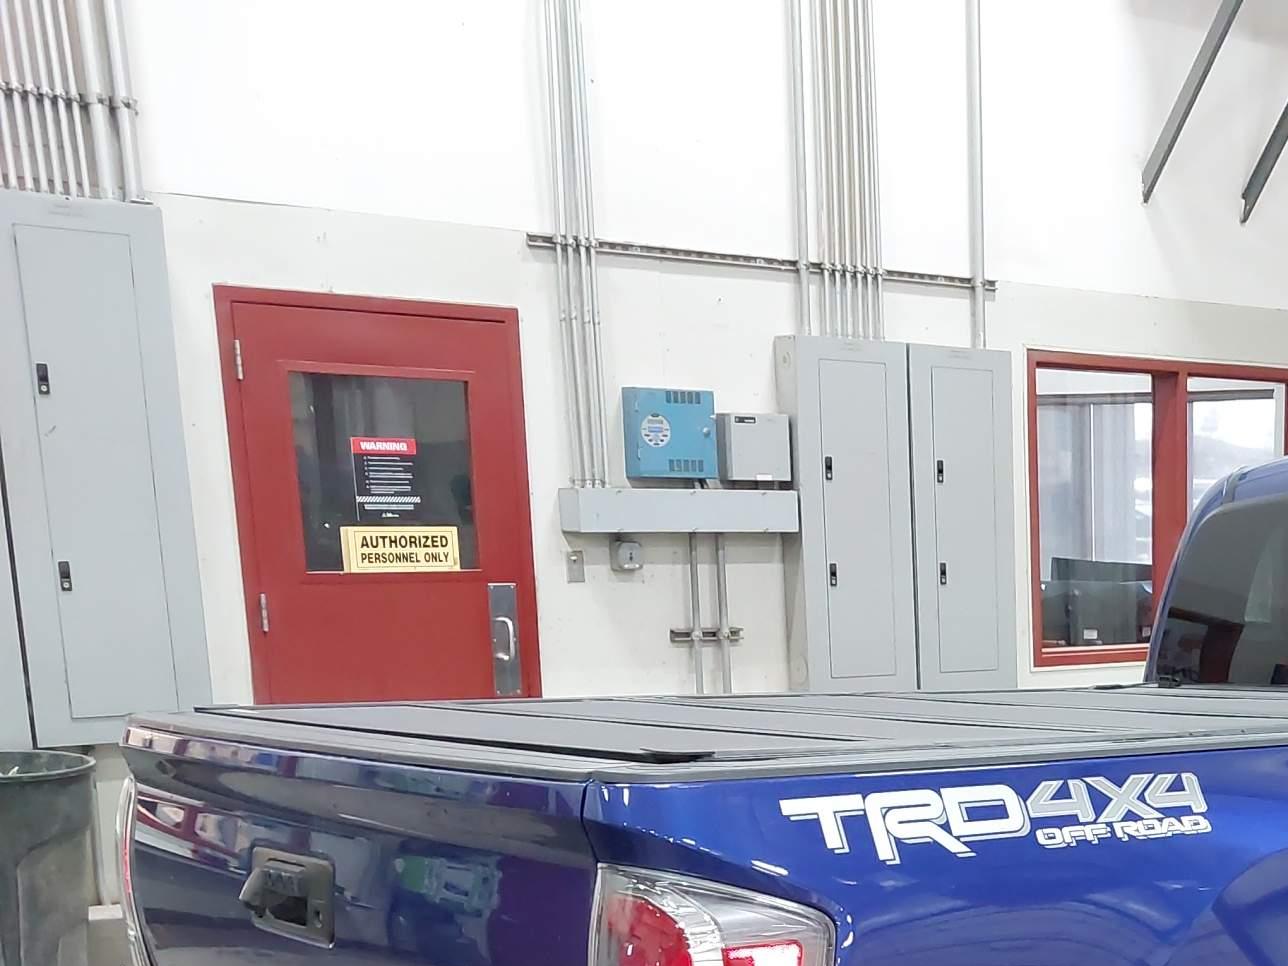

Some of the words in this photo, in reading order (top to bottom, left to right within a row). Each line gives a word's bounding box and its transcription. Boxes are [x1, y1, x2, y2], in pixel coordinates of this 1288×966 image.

[360, 441, 408, 451] WARNING
[360, 535, 449, 549] AUTHORIZED
[360, 552, 421, 564] PERSONNEL
[424, 551, 449, 563] ONLY
[779, 783, 1031, 865] TRD
[1035, 826, 1111, 848] OFF
[1112, 815, 1212, 841] ROAD
